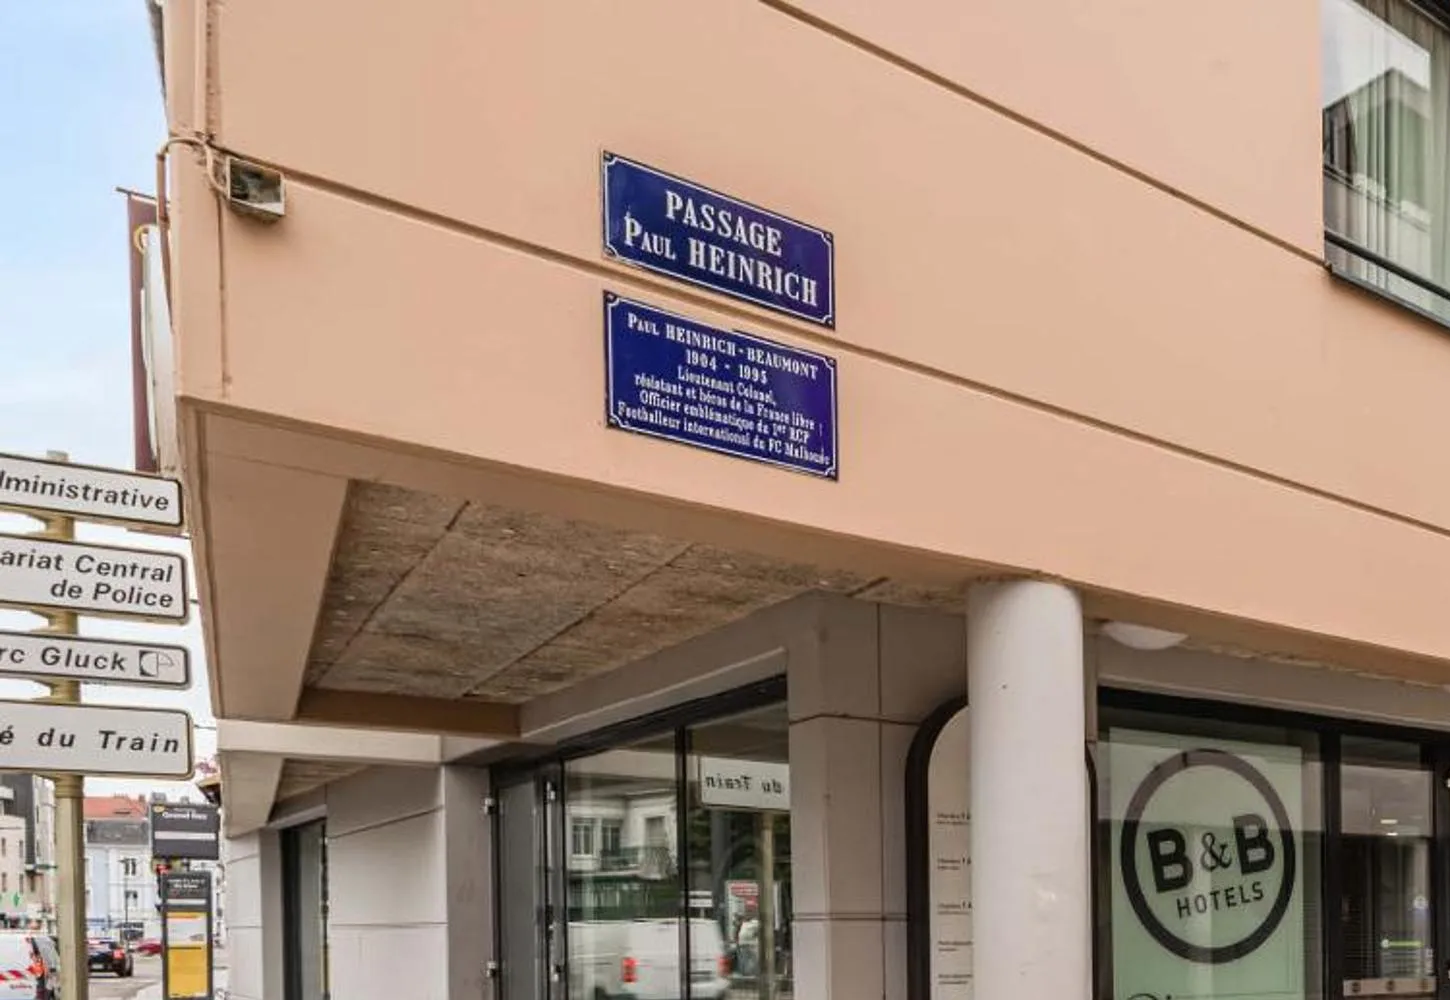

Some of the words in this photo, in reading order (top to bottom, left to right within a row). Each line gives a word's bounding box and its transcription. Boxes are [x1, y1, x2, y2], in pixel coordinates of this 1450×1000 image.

[665, 190, 782, 257] PASSAGE
[624, 213, 677, 260] PAUL
[688, 237, 818, 307] HEINRICH
[628, 312, 660, 336] PAUL
[686, 348, 717, 371] 1904
[739, 364, 767, 384] 1995
[75, 553, 174, 583] Central
[50, 580, 83, 601] de
[92, 581, 174, 609] Police
[41, 646, 127, 673] Gluck
[38, 727, 75, 748] du
[99, 729, 179, 753] Train
[1147, 813, 1275, 894] B&B
[1176, 880, 1265, 919] HOTELS
